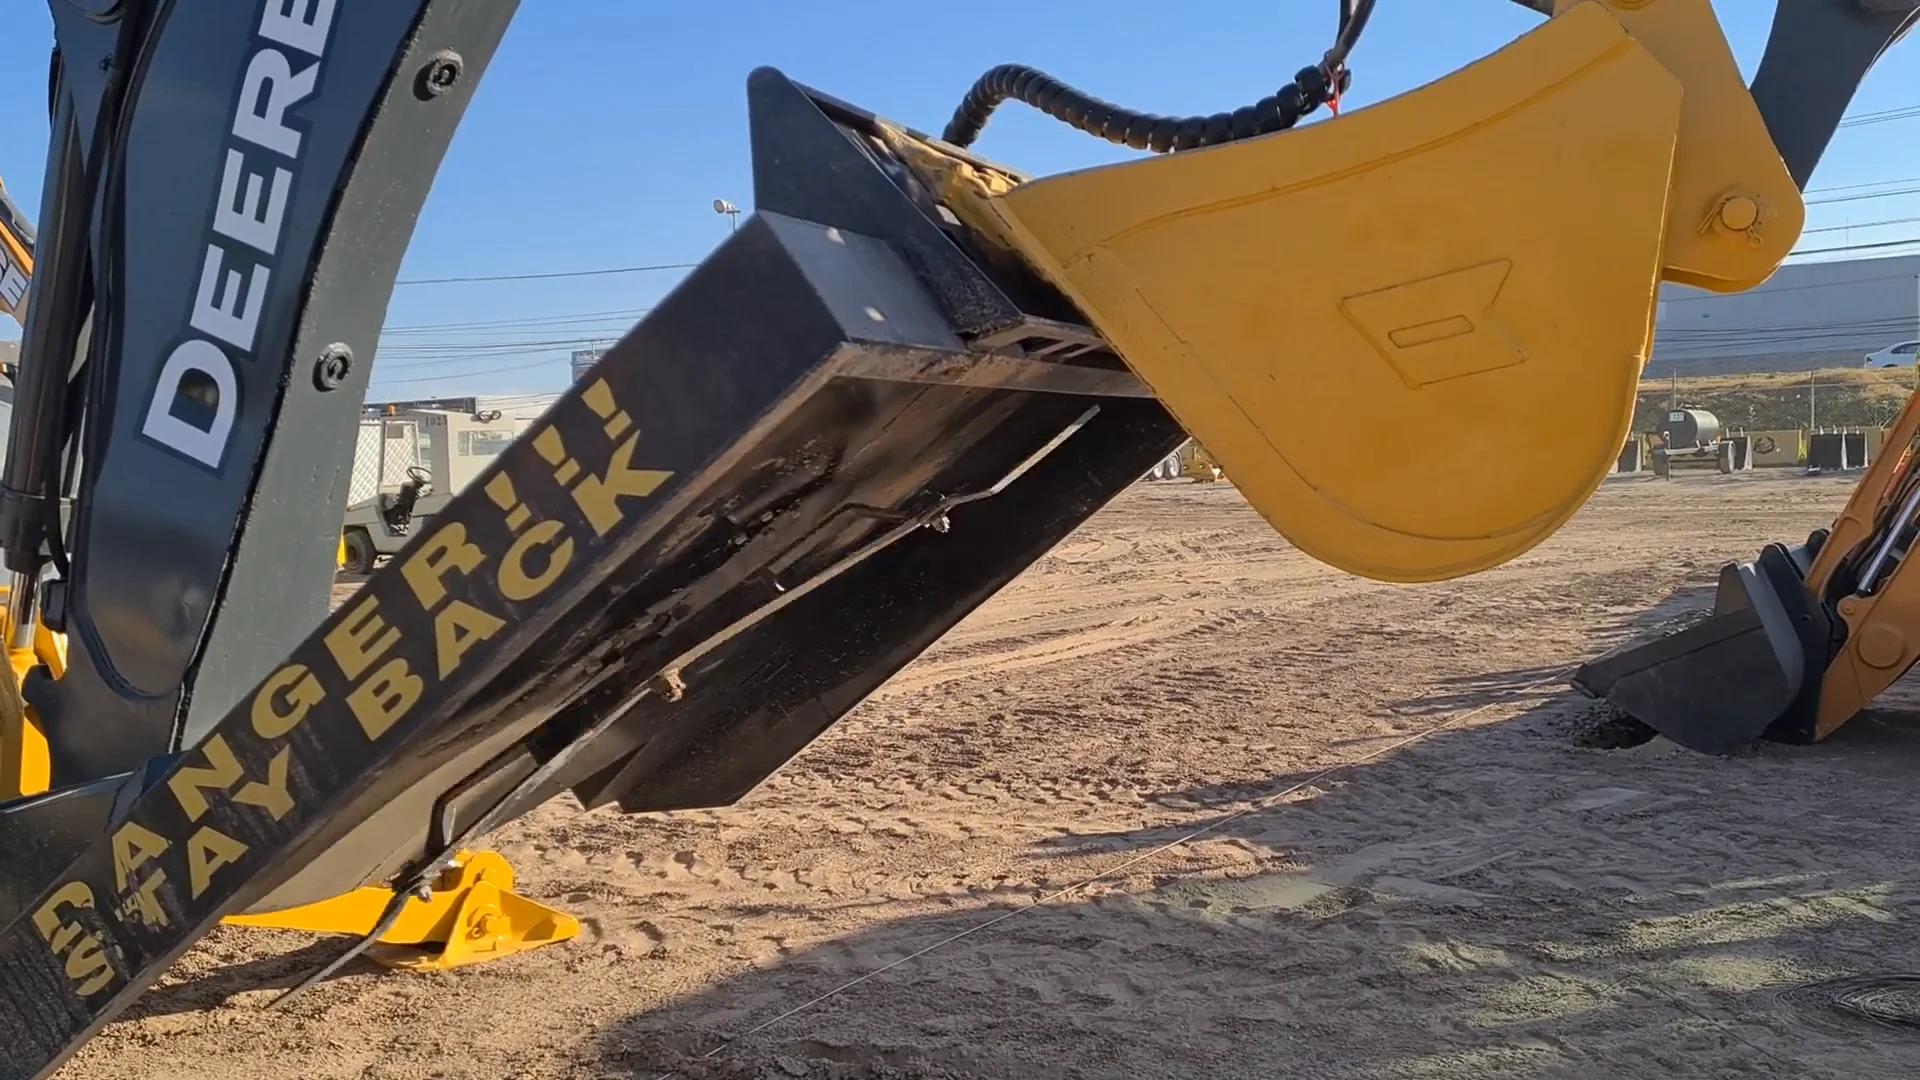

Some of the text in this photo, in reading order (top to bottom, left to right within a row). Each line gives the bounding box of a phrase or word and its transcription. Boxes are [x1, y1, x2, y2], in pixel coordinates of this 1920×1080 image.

[142, 0, 337, 469] DEERE
[66, 429, 675, 996] STAY BACK
